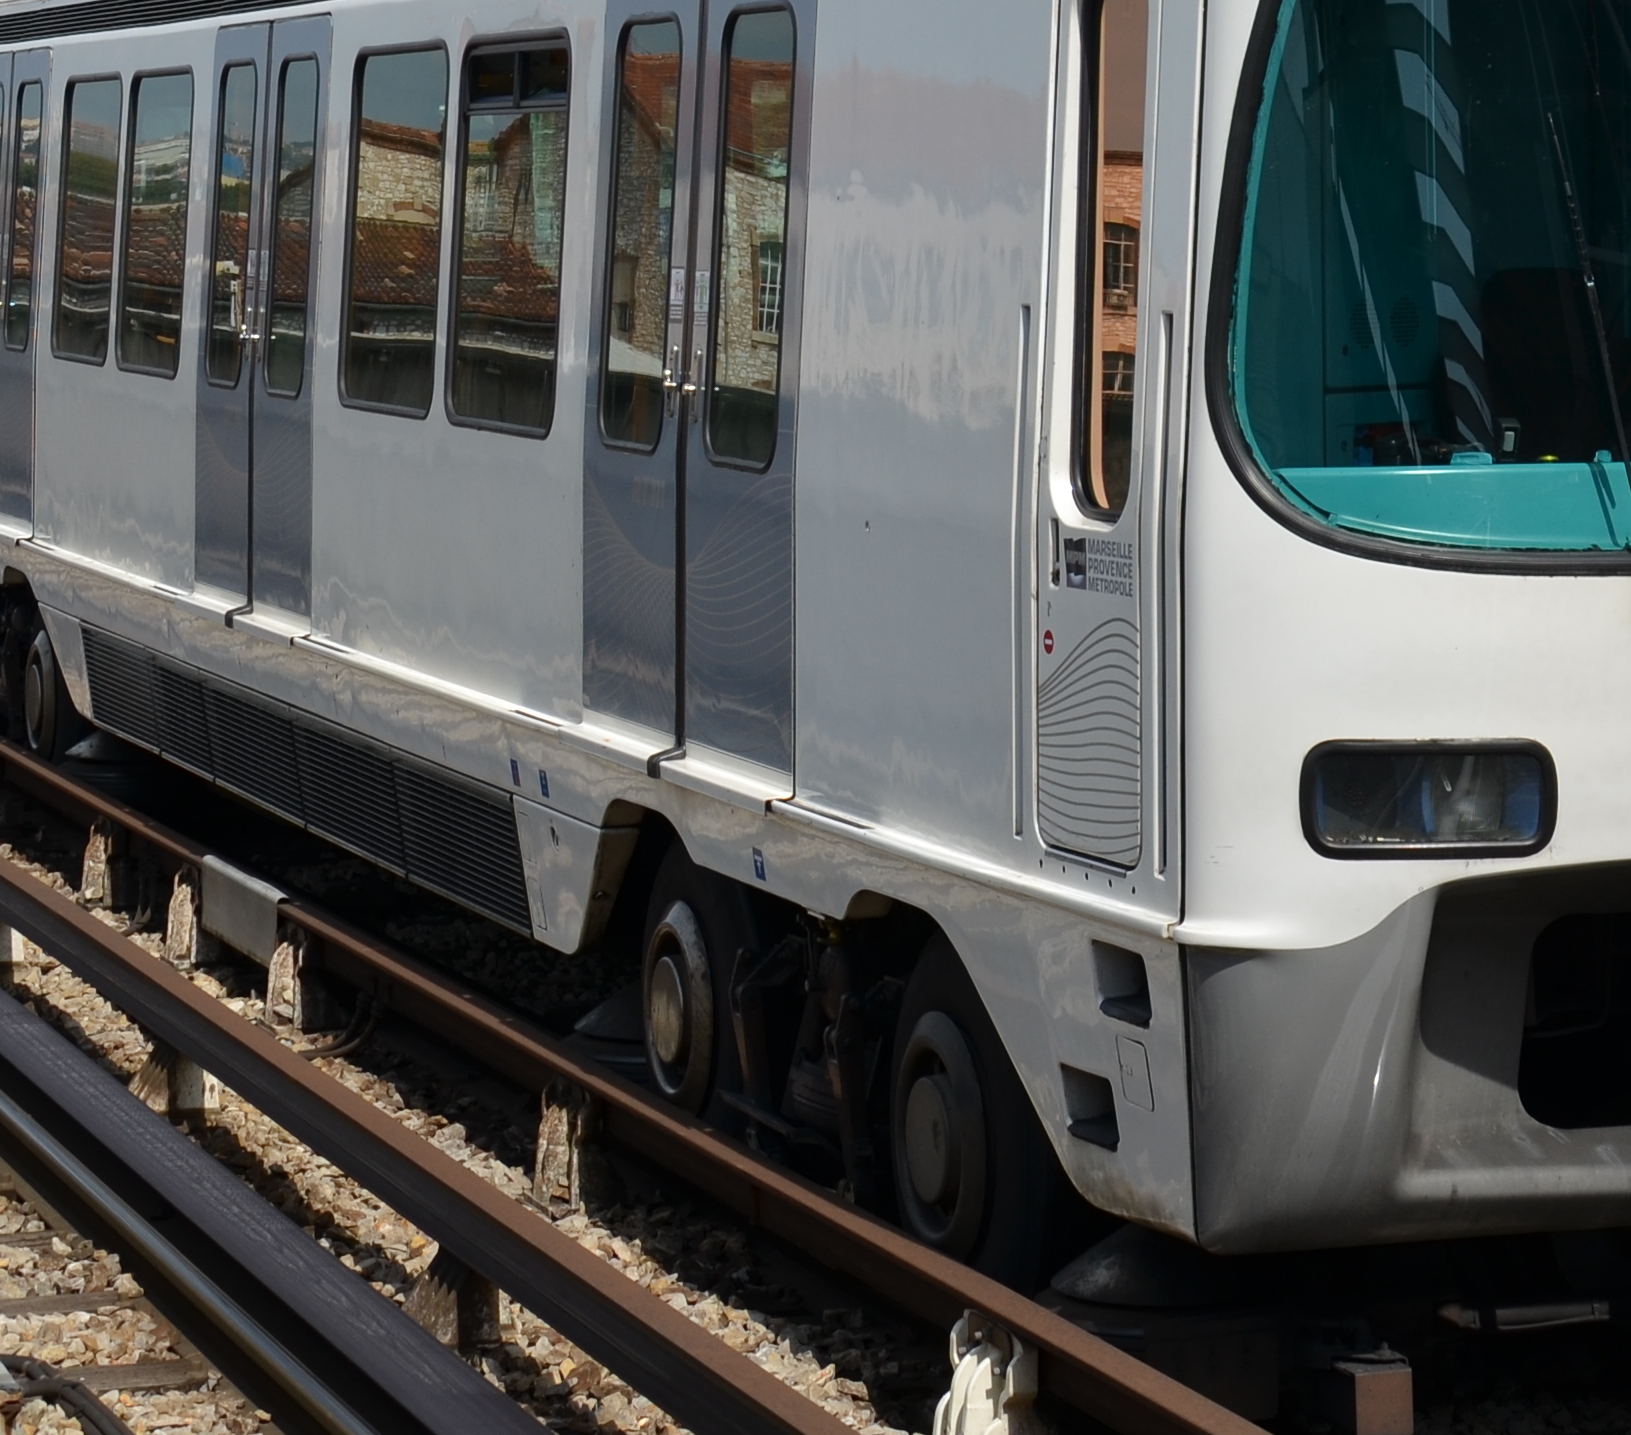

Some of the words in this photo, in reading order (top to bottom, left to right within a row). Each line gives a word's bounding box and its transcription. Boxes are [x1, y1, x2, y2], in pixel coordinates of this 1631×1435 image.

[1087, 538, 1134, 560] MARSEILLE
[1087, 557, 1134, 579] PROVENCE
[1087, 576, 1134, 597] METROPOLE
